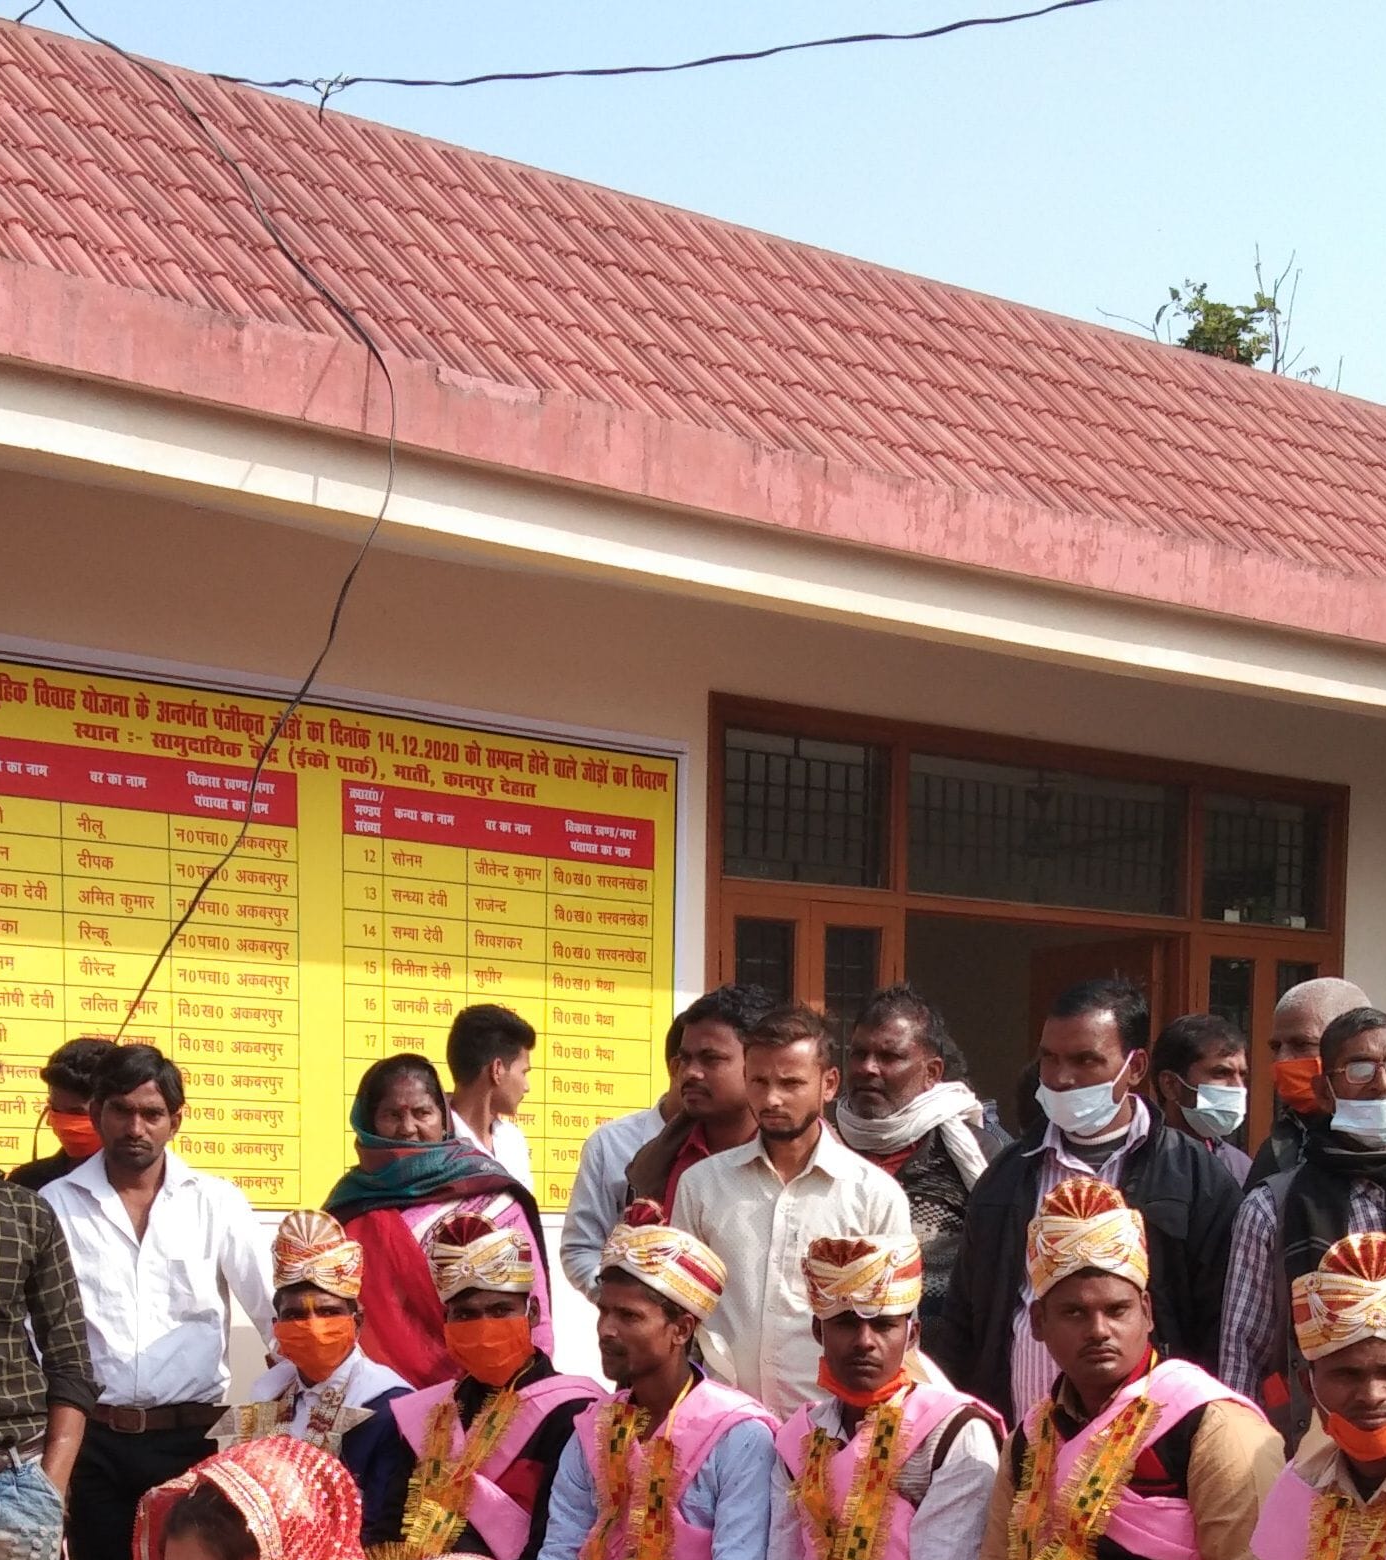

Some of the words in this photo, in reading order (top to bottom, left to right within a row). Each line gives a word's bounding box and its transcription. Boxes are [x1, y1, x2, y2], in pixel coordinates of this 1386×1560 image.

[34, 678, 75, 710] विवाह
[81, 685, 129, 717] योजना
[134, 693, 150, 720] के
[157, 700, 208, 728] अन्तर्गत
[213, 703, 265, 741] पंजीकृत
[306, 715, 325, 743] का
[329, 718, 372, 749] दिनांक
[378, 731, 459, 763] 14.12.2020
[465, 740, 481, 766] को
[486, 747, 523, 772] सम्पन्न
[528, 749, 549, 776] होने
[554, 754, 577, 780] वाले
[581, 757, 608, 789] जोड़ों
[613, 766, 628, 787] का
[632, 764, 668, 792] विवरण
[6, 761, 22, 774] का
[25, 764, 49, 777] नाम
[73, 722, 119, 743] स्थान
[151, 732, 243, 757] सामुदायिक
[443, 771, 494, 796] कानपुर
[500, 775, 536, 798] देहात
[107, 773, 122, 786] का
[126, 775, 147, 788] नाम
[186, 771, 220, 788] विकास
[194, 795, 228, 810] पंचायत
[232, 799, 245, 812] का
[76, 812, 106, 839] नीलू
[394, 807, 418, 820] कन्या
[421, 812, 433, 823] का
[437, 813, 455, 826] नाम
[499, 821, 511, 833] का
[514, 823, 532, 836] नाम
[77, 849, 114, 870] दीपक
[364, 850, 376, 863] 12
[391, 848, 422, 868] सोनम
[600, 846, 612, 857] का
[615, 848, 631, 858] नाम
[235, 869, 288, 892] अकबरपुर
[513, 866, 542, 885] कुमार
[23, 880, 47, 901] देवी
[78, 885, 114, 907] अमित
[120, 893, 155, 914] कुमार
[363, 887, 377, 900] 13
[428, 889, 447, 907] देवी
[235, 903, 289, 927] अकबरपुर
[78, 920, 112, 947] रिन्कू
[362, 923, 376, 937] 14
[424, 925, 443, 943] देवी
[236, 938, 289, 961] अकबरपुर
[79, 957, 116, 977] वीरेन्द्र
[364, 960, 377, 974] 15
[391, 958, 427, 978] विनीता
[432, 962, 451, 980] देवी
[237, 972, 290, 994] अकबरपुर
[30, 990, 54, 1009] देवी
[80, 994, 118, 1013] ललित
[364, 998, 377, 1011] 16
[392, 997, 428, 1016] जानकी
[433, 998, 453, 1016] देवी
[230, 1007, 283, 1028] अकबरपुर
[365, 1034, 377, 1047] 17
[231, 1040, 283, 1062] अकबरपुर
[231, 1074, 283, 1095] अकबरपुर
[231, 1108, 284, 1128] अकबरपुर
[231, 1142, 284, 1161] अकबरपुर
